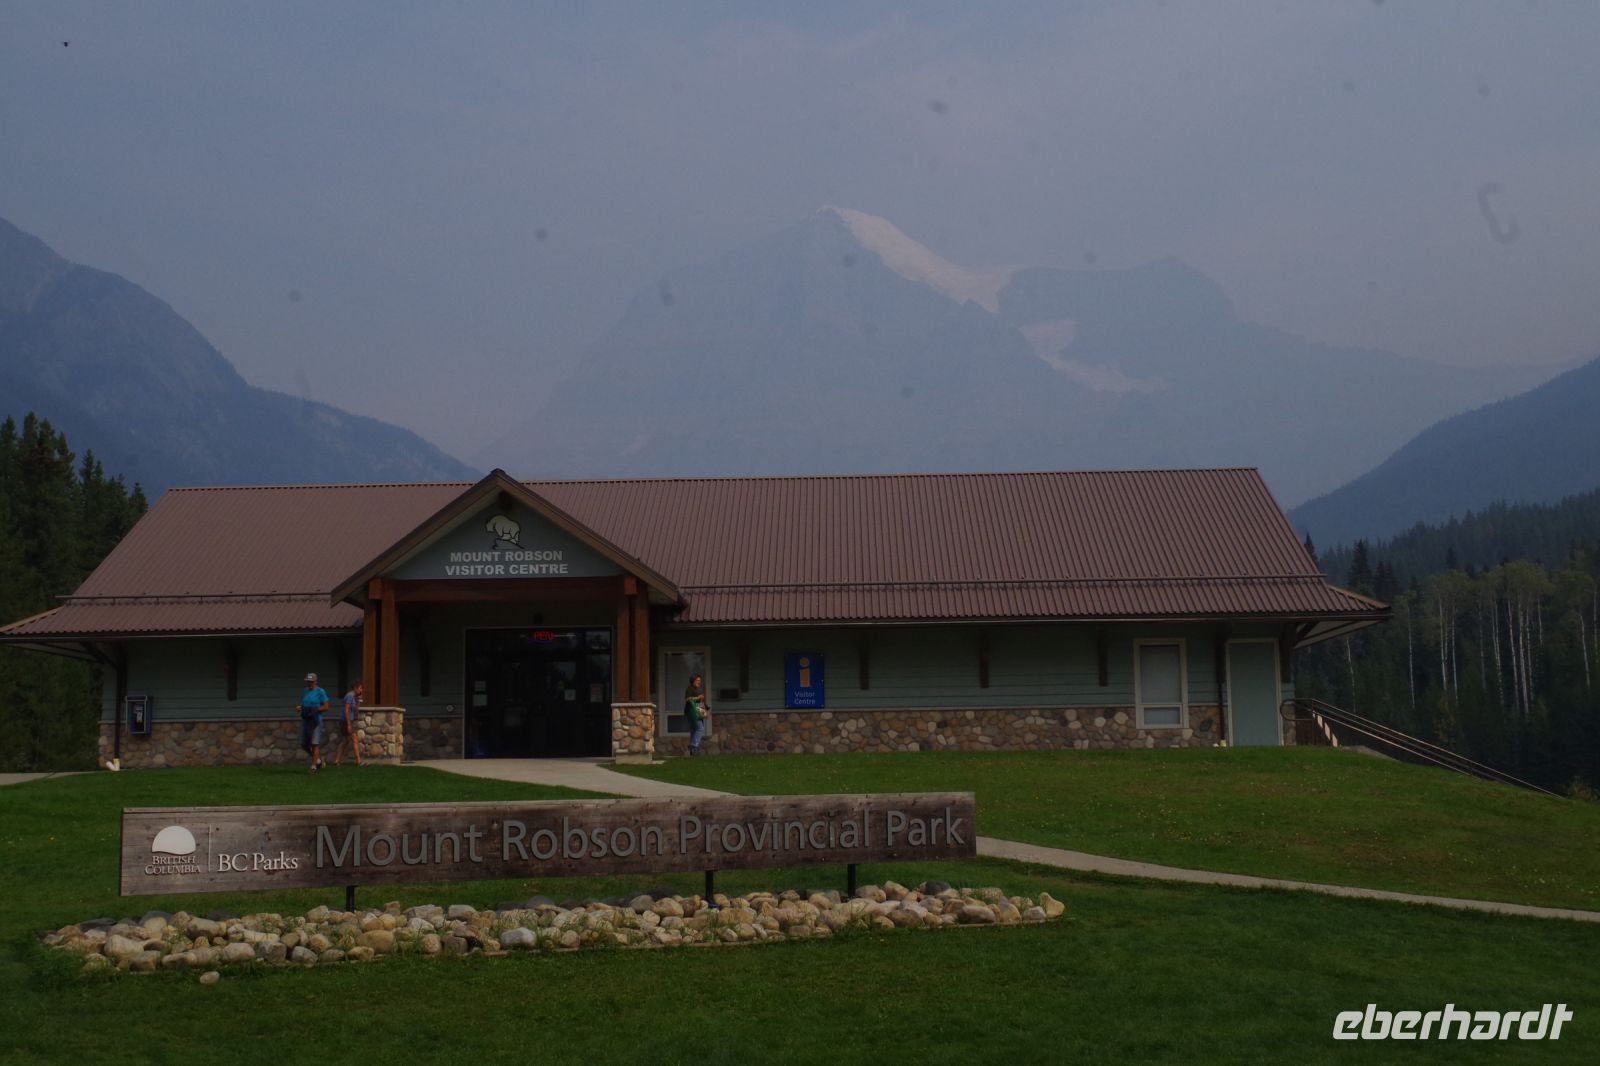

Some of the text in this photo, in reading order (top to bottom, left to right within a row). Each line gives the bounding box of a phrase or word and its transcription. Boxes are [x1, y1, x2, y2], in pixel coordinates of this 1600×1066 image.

[450, 550, 563, 562] MOUNT ROBSON
[445, 563, 569, 576] VISITOR CENTRE
[315, 806, 966, 869] Mount Robson Provincial Park
[152, 855, 196, 865] BRITISH
[217, 851, 299, 873] BC Parks
[144, 864, 201, 876] COLUMBIA
